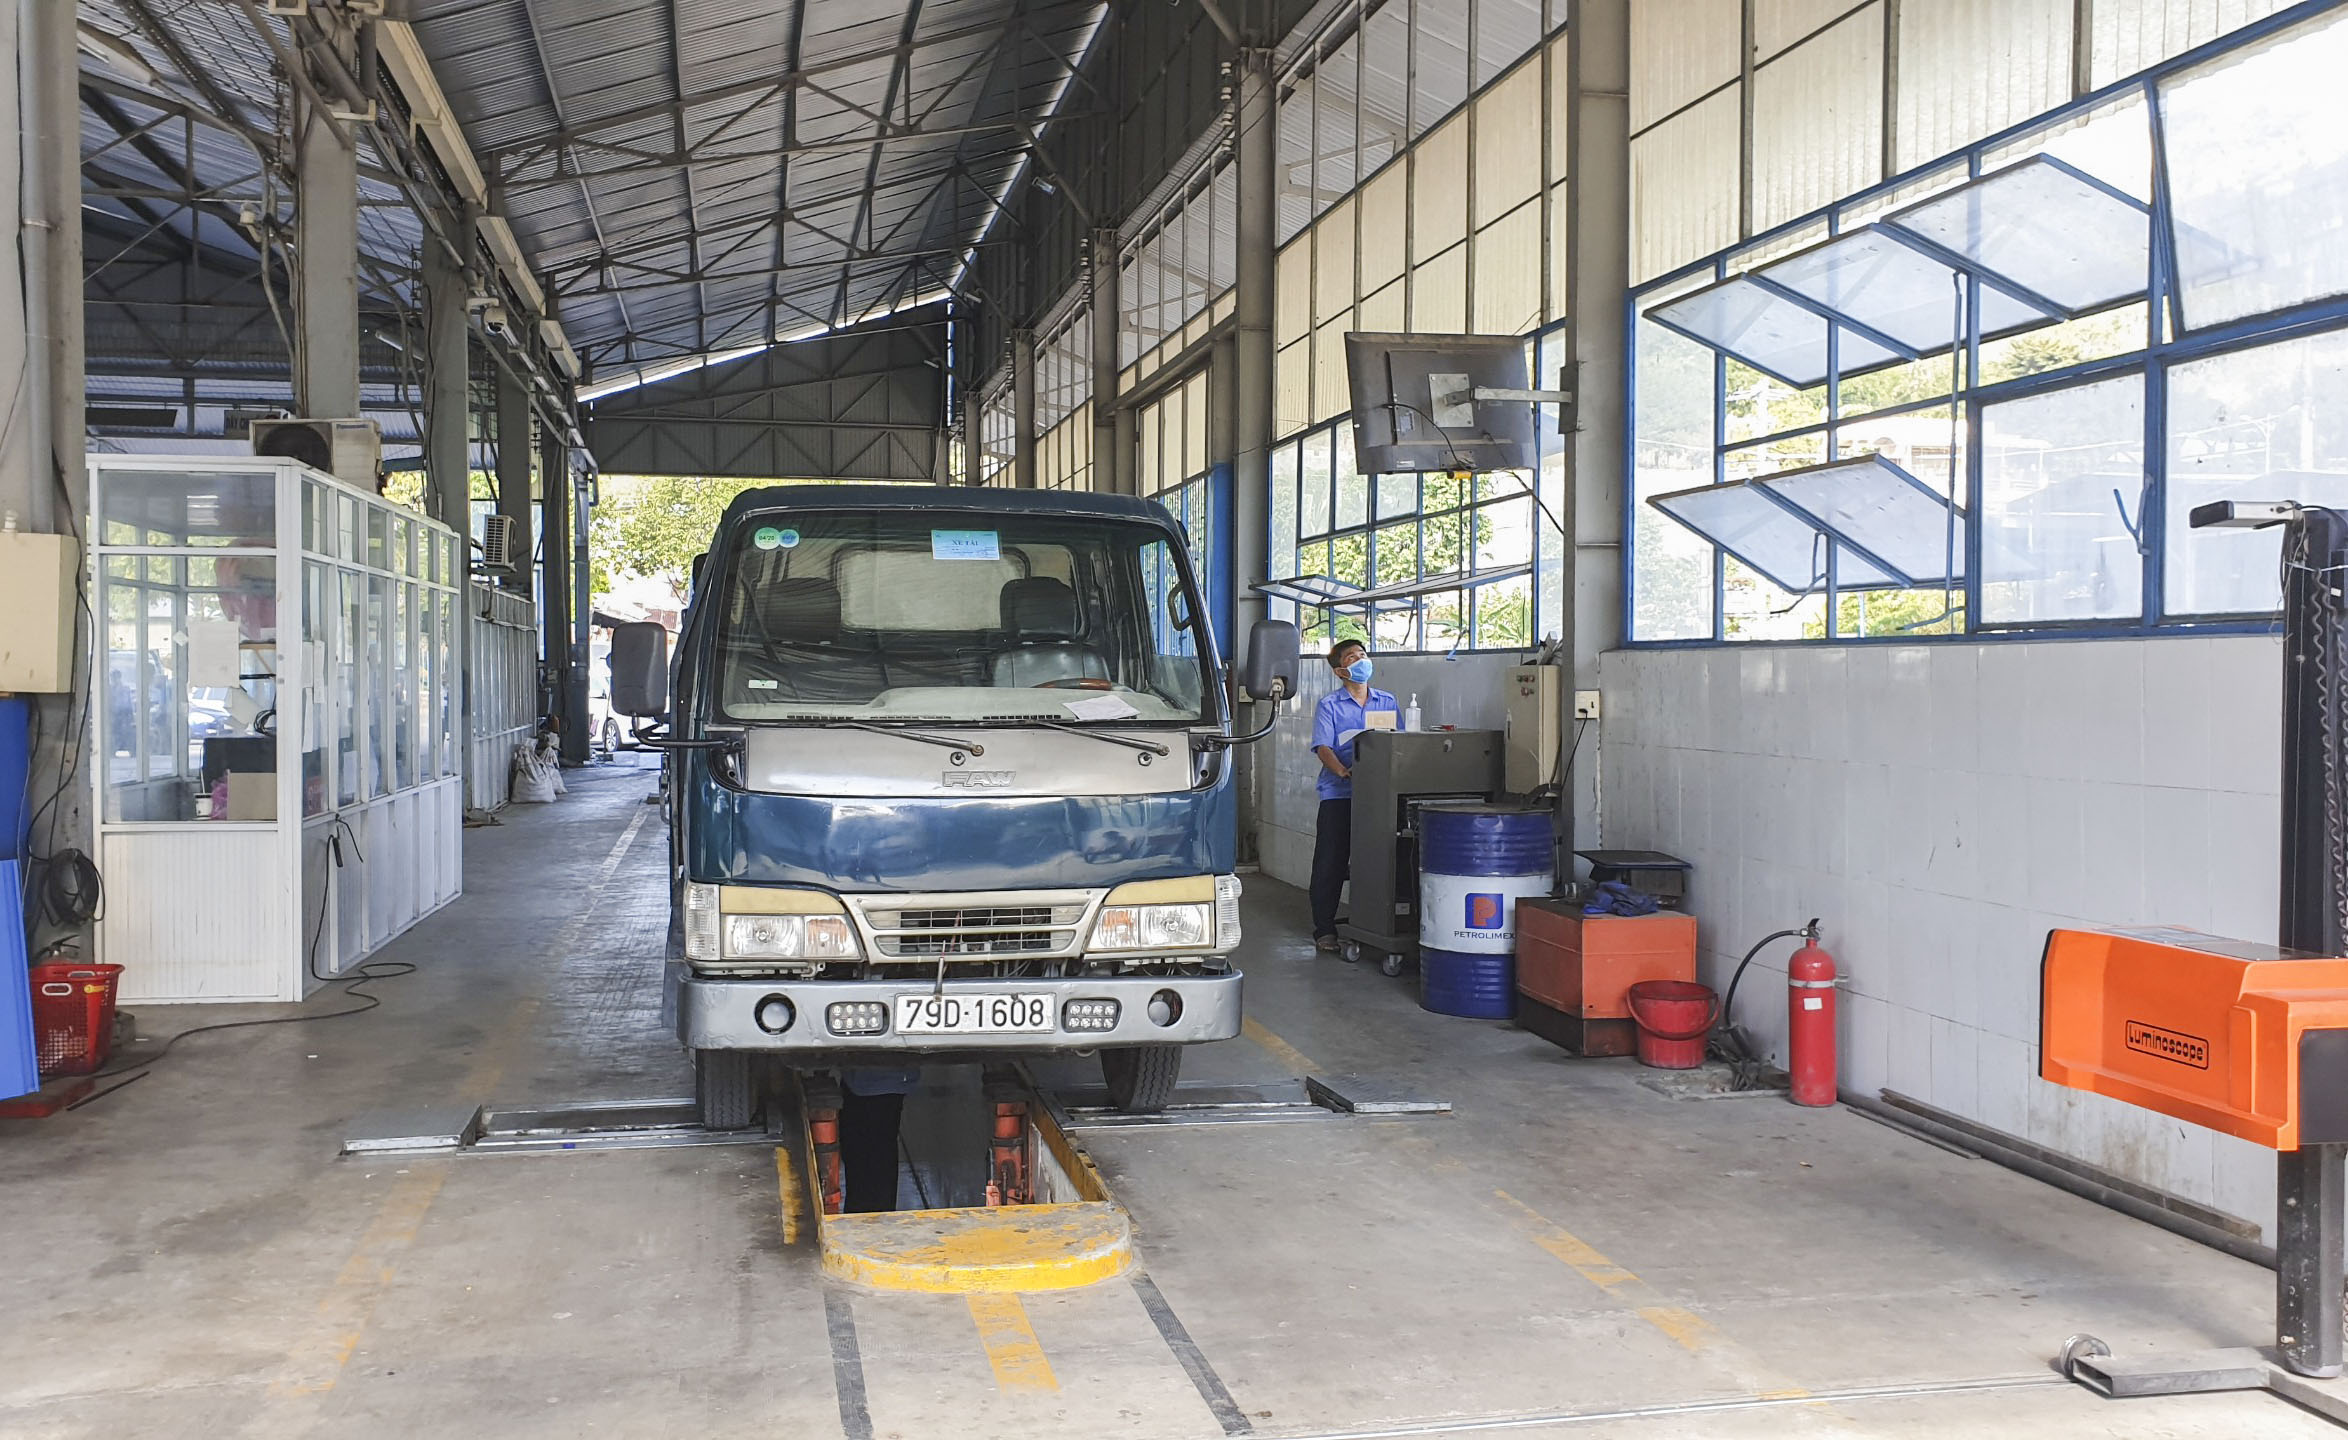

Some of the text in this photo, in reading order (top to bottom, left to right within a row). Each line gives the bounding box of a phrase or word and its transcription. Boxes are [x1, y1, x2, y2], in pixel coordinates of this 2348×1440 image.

[942, 770, 1017, 788] FAW
[1453, 930, 1515, 940] PETROLIMEX
[2128, 1024, 2203, 1061] Luminoscope
